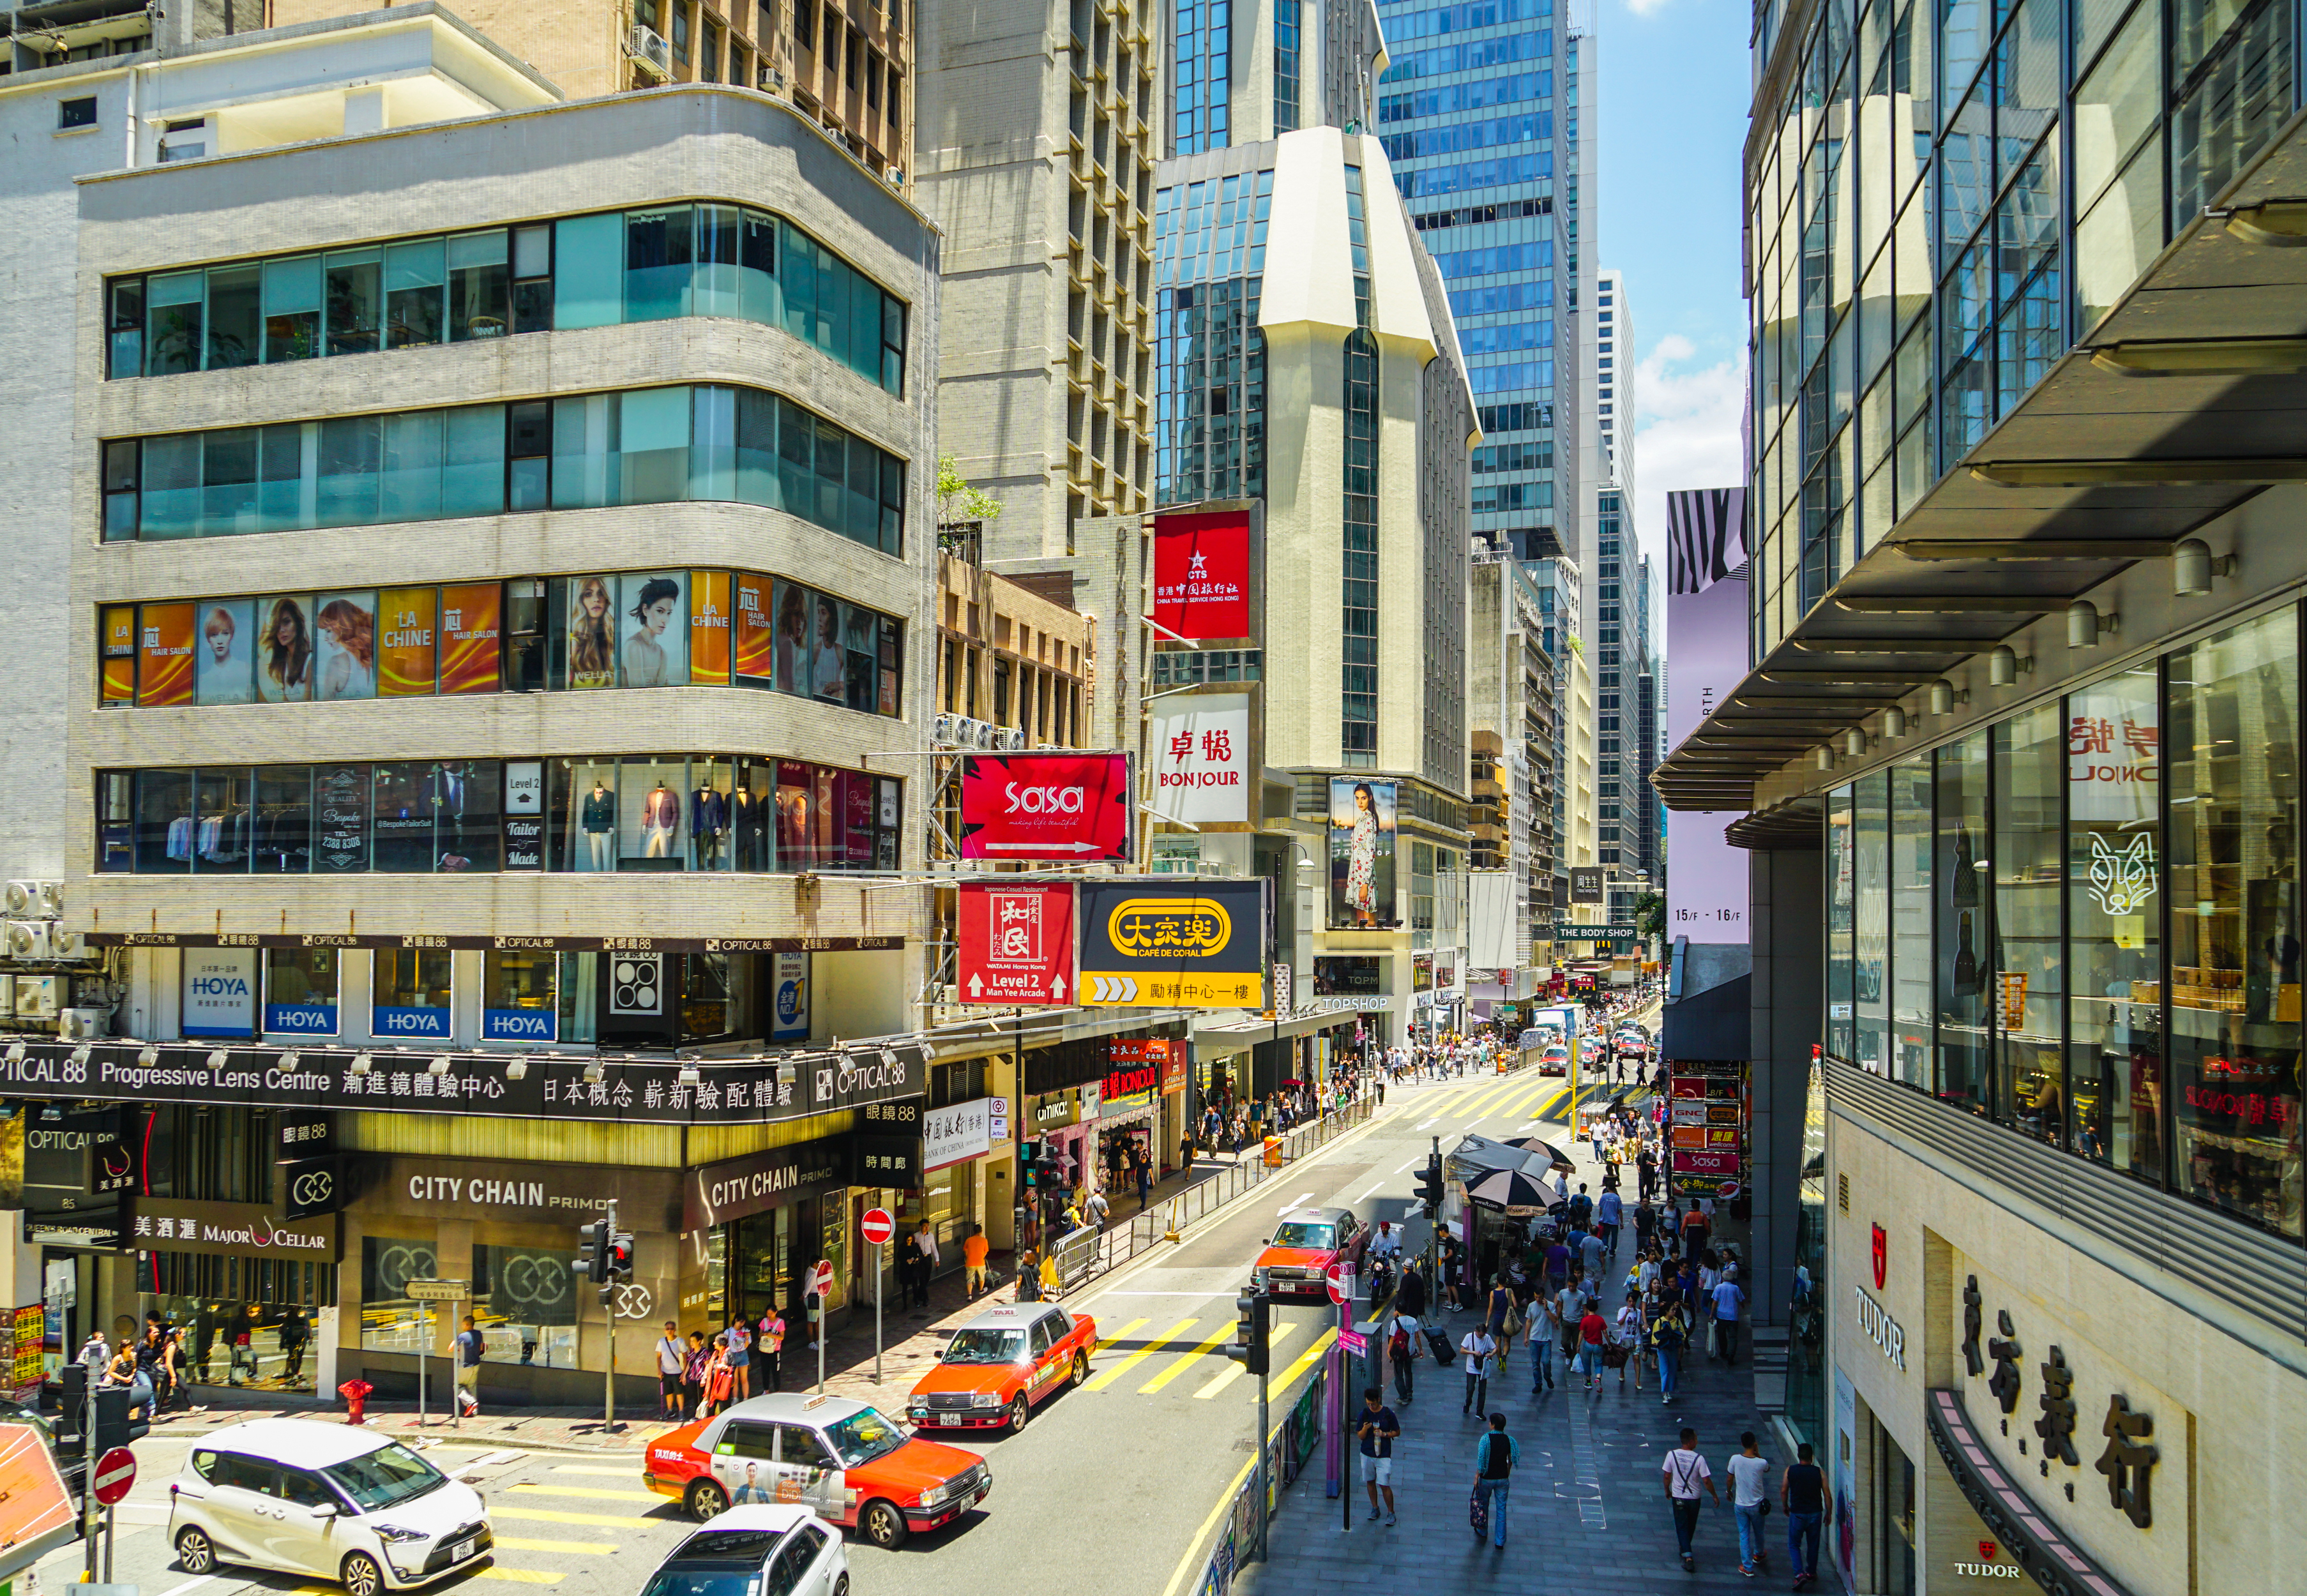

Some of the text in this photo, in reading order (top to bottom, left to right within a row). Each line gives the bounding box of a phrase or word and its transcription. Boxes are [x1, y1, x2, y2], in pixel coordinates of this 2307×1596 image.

[1188, 570, 1207, 580] CTS
[702, 605, 718, 615] LA
[748, 612, 765, 621] HAIR
[398, 611, 417, 628] LA
[692, 615, 729, 628] CHINE
[748, 618, 771, 628] SALON
[116, 626, 128, 637] LA
[453, 629, 497, 640] HAIR SALON
[384, 629, 431, 648] CHINE
[151, 647, 191, 656] HAIR SALON
[575, 670, 613, 680] WELLA
[510, 778, 540, 789] Level 2
[1160, 771, 1239, 790] BONJOUR
[328, 795, 357, 803] QUALITY
[322, 808, 361, 825] Bespoke
[1008, 817, 1079, 829] making life beautiful
[377, 819, 432, 829] @BespokeTailorSuit
[506, 822, 540, 836] Tailor
[322, 836, 361, 849] 2388 8308
[508, 852, 539, 865] Made
[1577, 875, 1598, 888] 周生生
[1029, 898, 1039, 924] 居食屋
[1675, 908, 1741, 922] 15/F 16/F
[999, 900, 1030, 956] 和民
[1607, 929, 1633, 937] SHOP
[136, 935, 176, 944] OPTICAL 88
[314, 936, 357, 945] OPTICAL 88
[414, 937, 447, 947] 眼鏡88
[508, 937, 554, 947] OPTICAL 88
[616, 938, 651, 950] 眼鏡88
[722, 940, 771, 951] OPTICAL 88
[863, 938, 888, 947] OPTICAL 88
[993, 932, 1002, 956] わたみ
[1138, 947, 1160, 957] CAFÉ
[190, 977, 248, 996] HOYA
[992, 974, 1040, 988] Level 2
[780, 991, 795, 1004] 全港
[986, 988, 1046, 997] Man Yee Arcade
[1322, 997, 1388, 1010] TOPSHOP
[276, 1011, 328, 1027] HOYA
[386, 1014, 440, 1030] HOYA
[491, 1016, 548, 1034] HOYA
[63, 1059, 87, 1083] 88
[102, 1063, 331, 1091] Progressive Lens Centre
[837, 1062, 905, 1094] OPTICAL 88
[1121, 1067, 1156, 1093] BONJOUR
[544, 1076, 633, 1108] 日本概念
[866, 1104, 916, 1122] 眼鏡88
[283, 1123, 326, 1143] 眼鏡88
[1711, 1131, 1734, 1142] 惠康
[924, 1141, 965, 1160] BANK OF CHINA
[865, 1155, 907, 1170] 時間廊
[712, 1164, 833, 1207] CITY CHAIN PRIMO
[409, 1175, 607, 1210] CITY CHAIN PRIMO
[62, 1198, 75, 1210] 85
[1474, 1199, 1499, 1210] www.ft.com
[25, 1223, 114, 1237] QUEEN'S ROAD CENTRAL
[1856, 1285, 1906, 1372] TUDOR
[654, 1449, 670, 1460] TAXI
[669, 1450, 684, 1461] 的士
[458, 1542, 467, 1552] HR
[458, 1547, 469, 1560] 261
[1954, 1562, 2021, 1579] TUDOR
